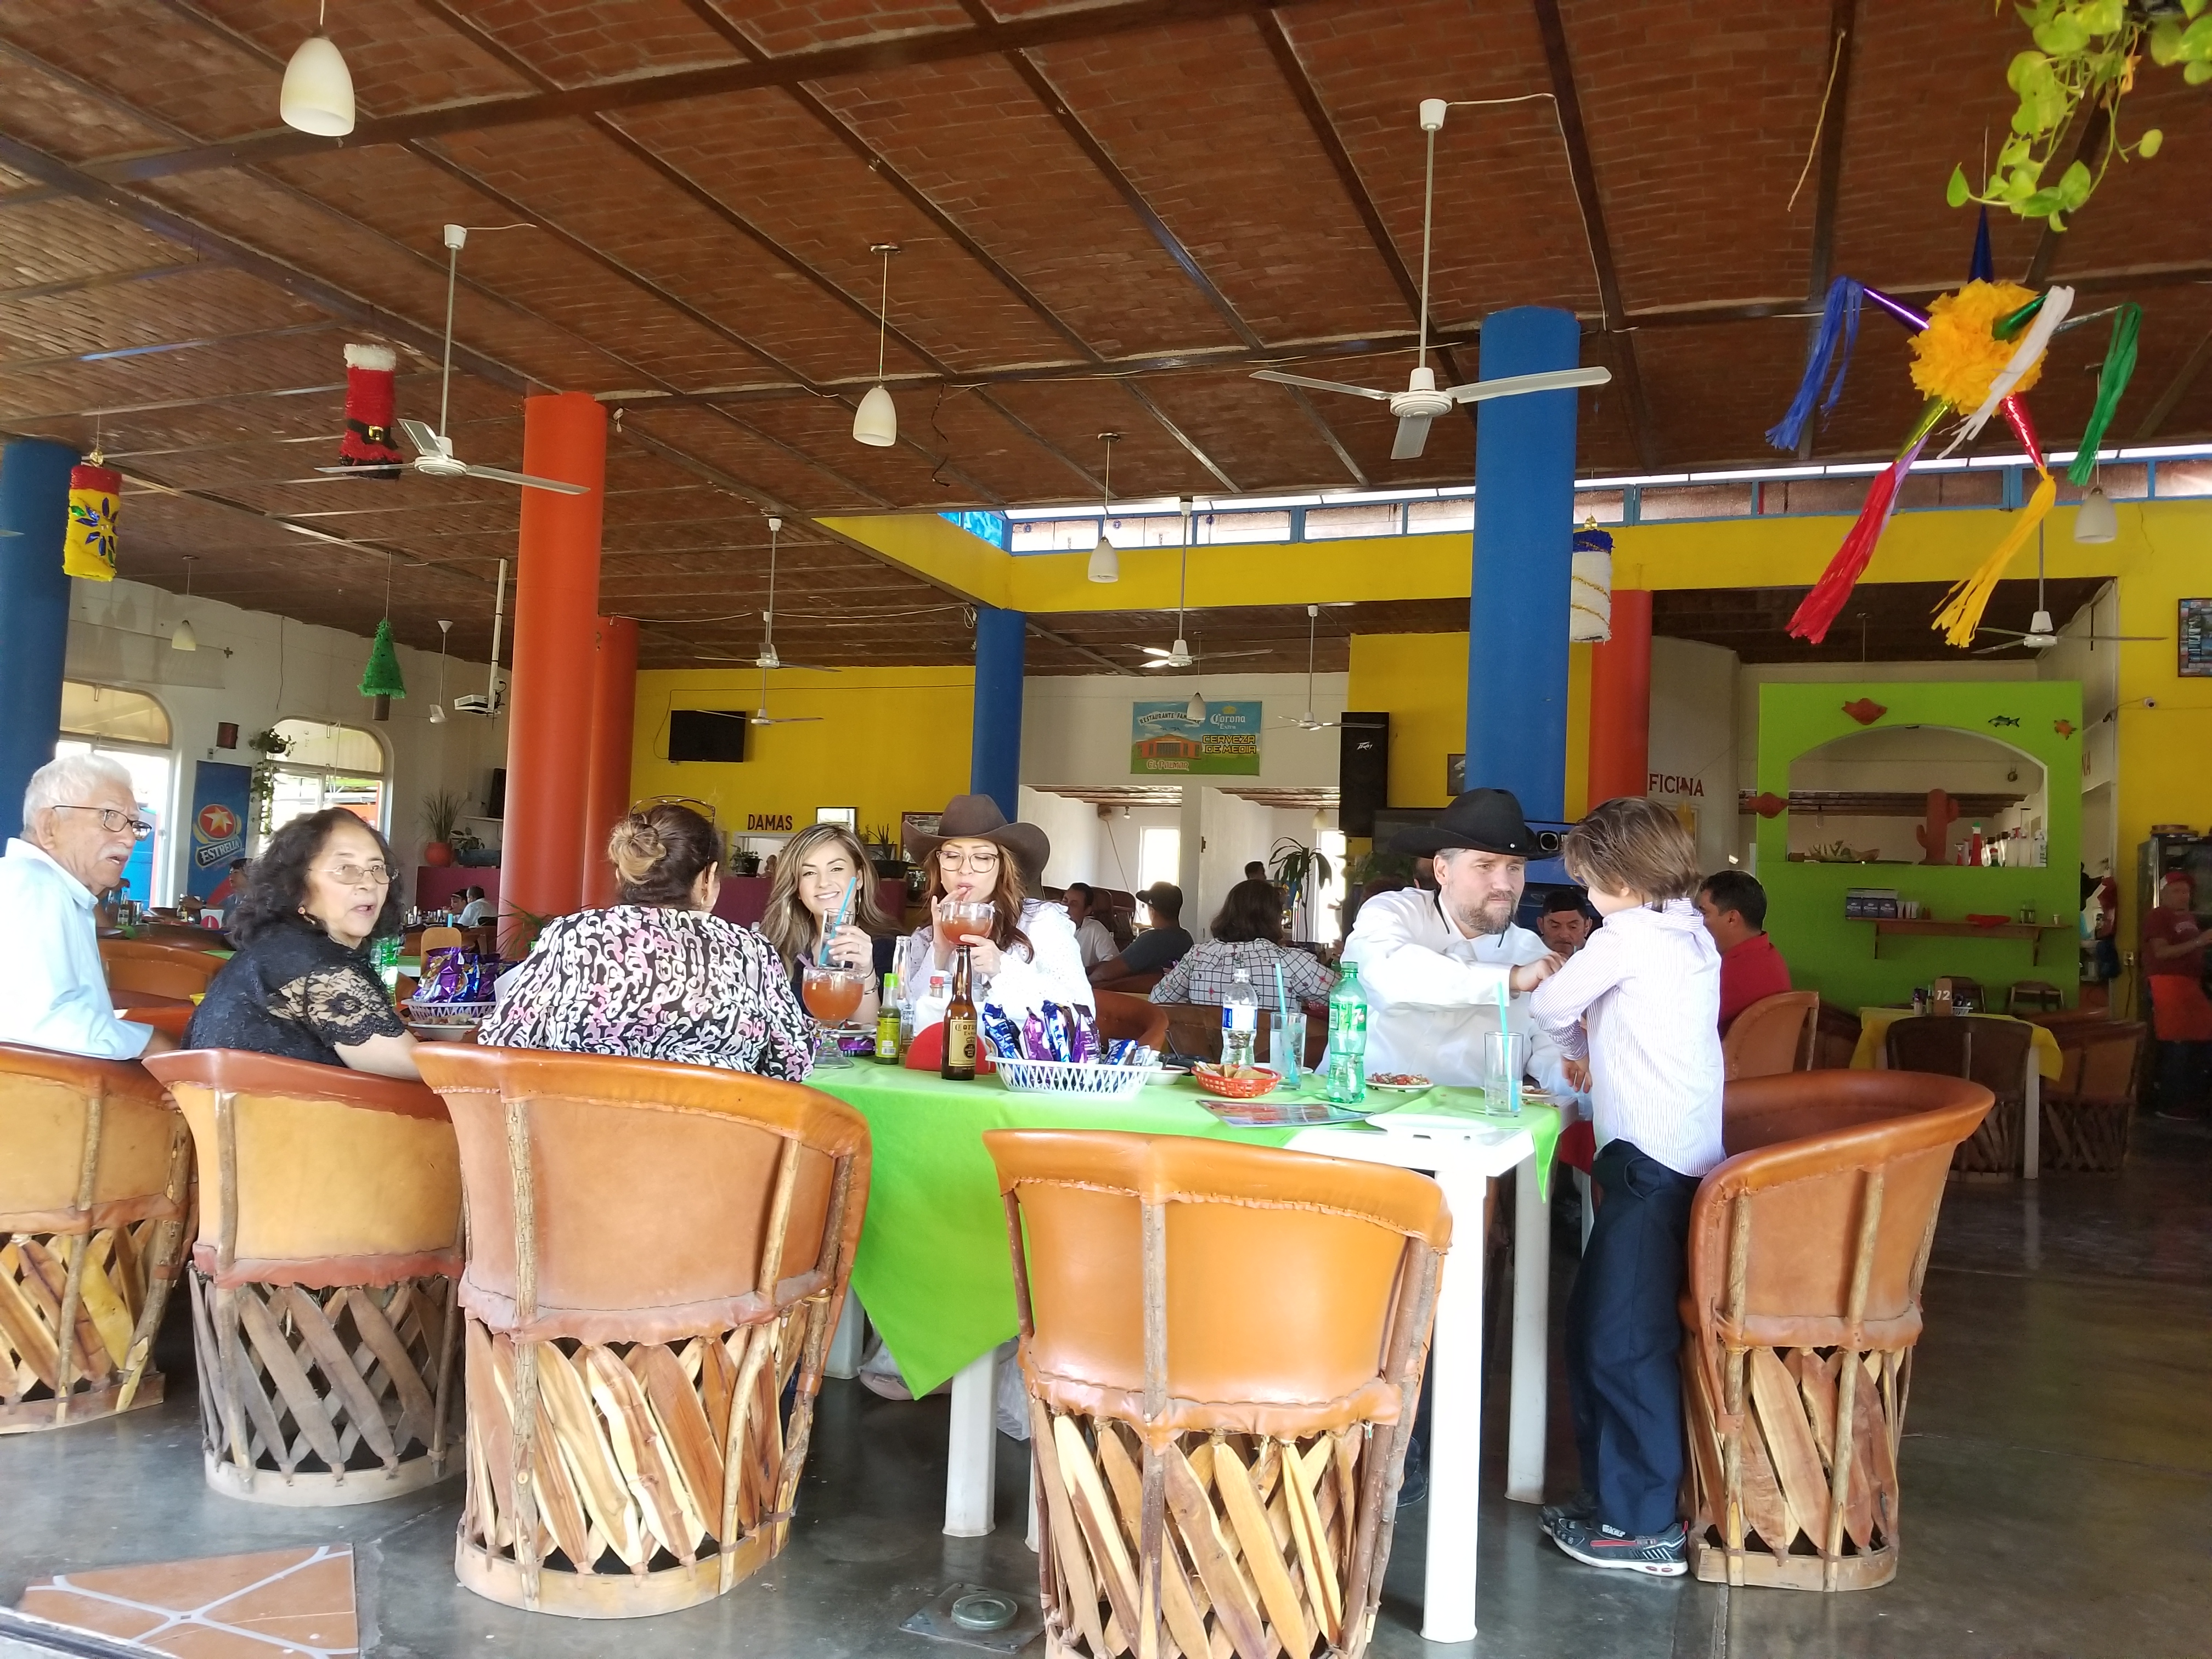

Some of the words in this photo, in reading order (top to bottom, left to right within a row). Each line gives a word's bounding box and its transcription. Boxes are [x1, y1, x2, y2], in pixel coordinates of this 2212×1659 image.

[1139, 713, 1174, 724] RESTAURANTE
[1210, 714, 1246, 725] Corona
[1203, 735, 1256, 744] CERVEZA
[1205, 744, 1221, 754] DE
[1222, 744, 1256, 754] MEDIA
[1649, 774, 1705, 797] FICINA
[747, 814, 793, 831] DAMAS
[200, 839, 240, 864] ESTRELLA
[1937, 990, 1950, 1001] 12
